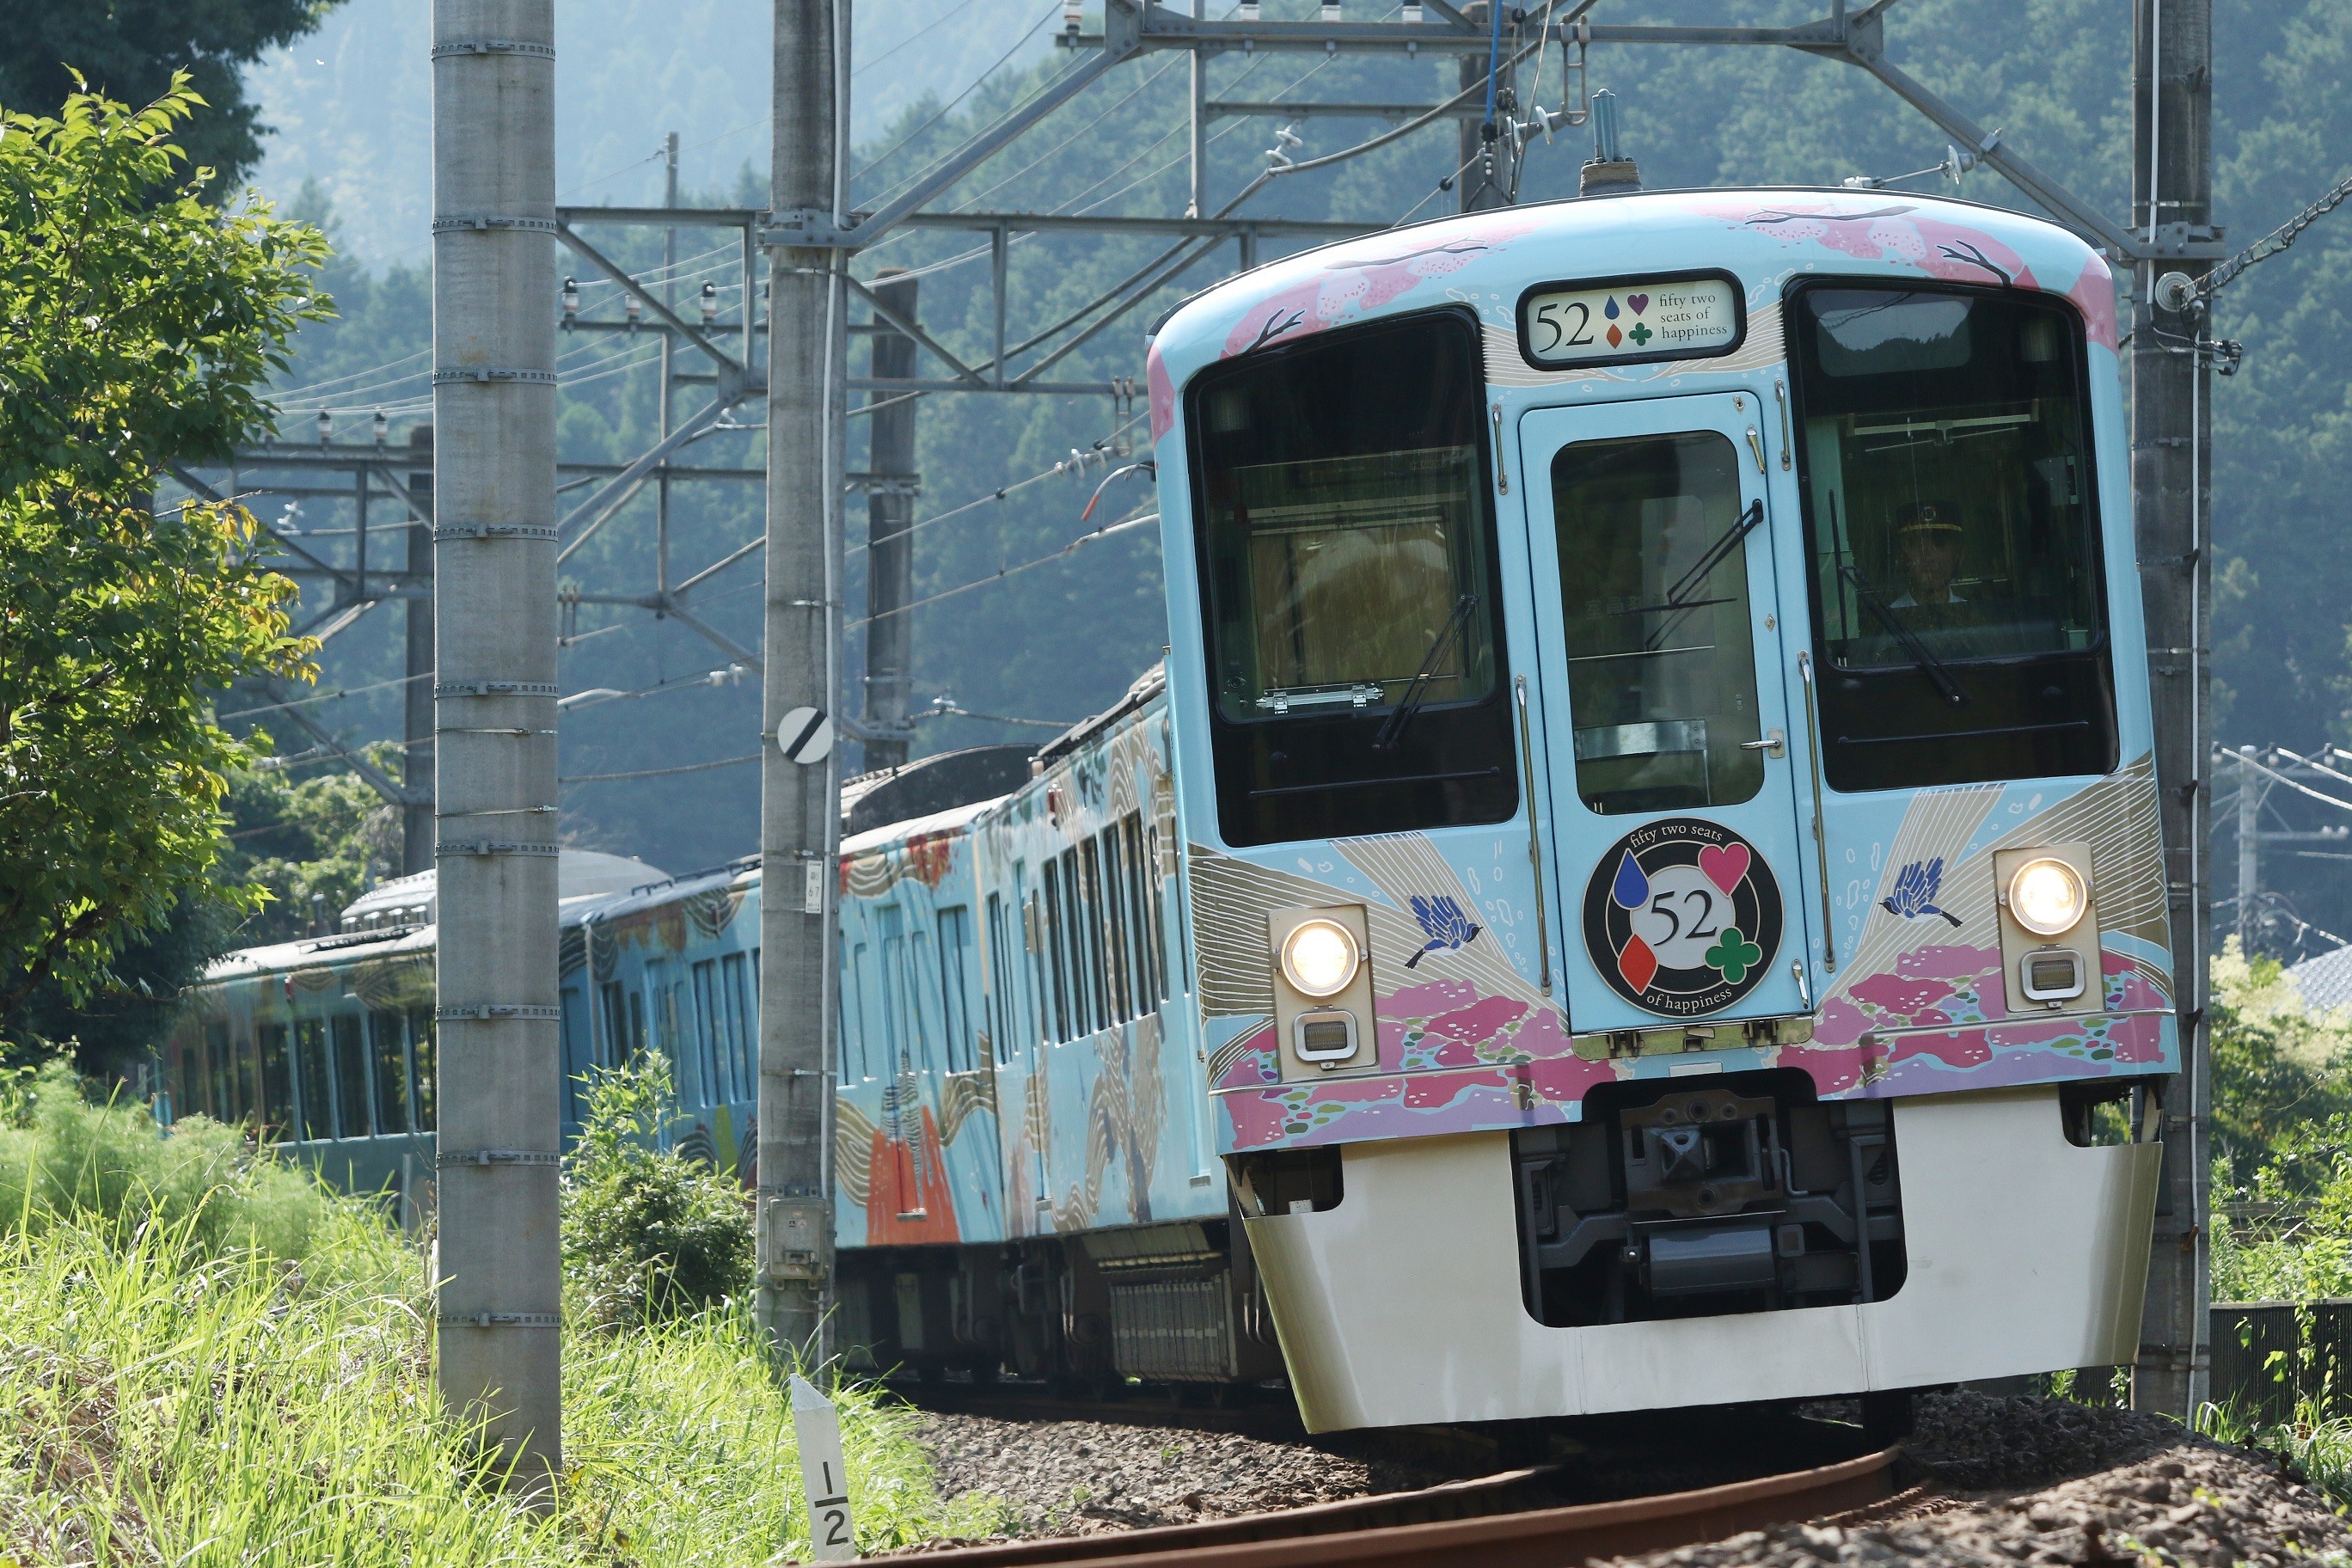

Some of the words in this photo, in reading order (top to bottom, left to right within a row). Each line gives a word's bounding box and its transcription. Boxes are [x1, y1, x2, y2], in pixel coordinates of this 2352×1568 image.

[1659, 293, 1686, 309] fifty
[1691, 295, 1716, 304] two
[1660, 312, 1691, 323] seats
[1696, 306, 1711, 320] of
[1536, 302, 1594, 352] 52
[1662, 325, 1727, 341] happiness
[1630, 830, 1657, 848] fifty
[1661, 825, 1687, 836] two
[1691, 825, 1723, 842] seats
[1651, 889, 1718, 946] 52
[1646, 994, 1664, 1007] of
[1664, 989, 1732, 1014] happiness
[823, 1510, 848, 1546] 2
